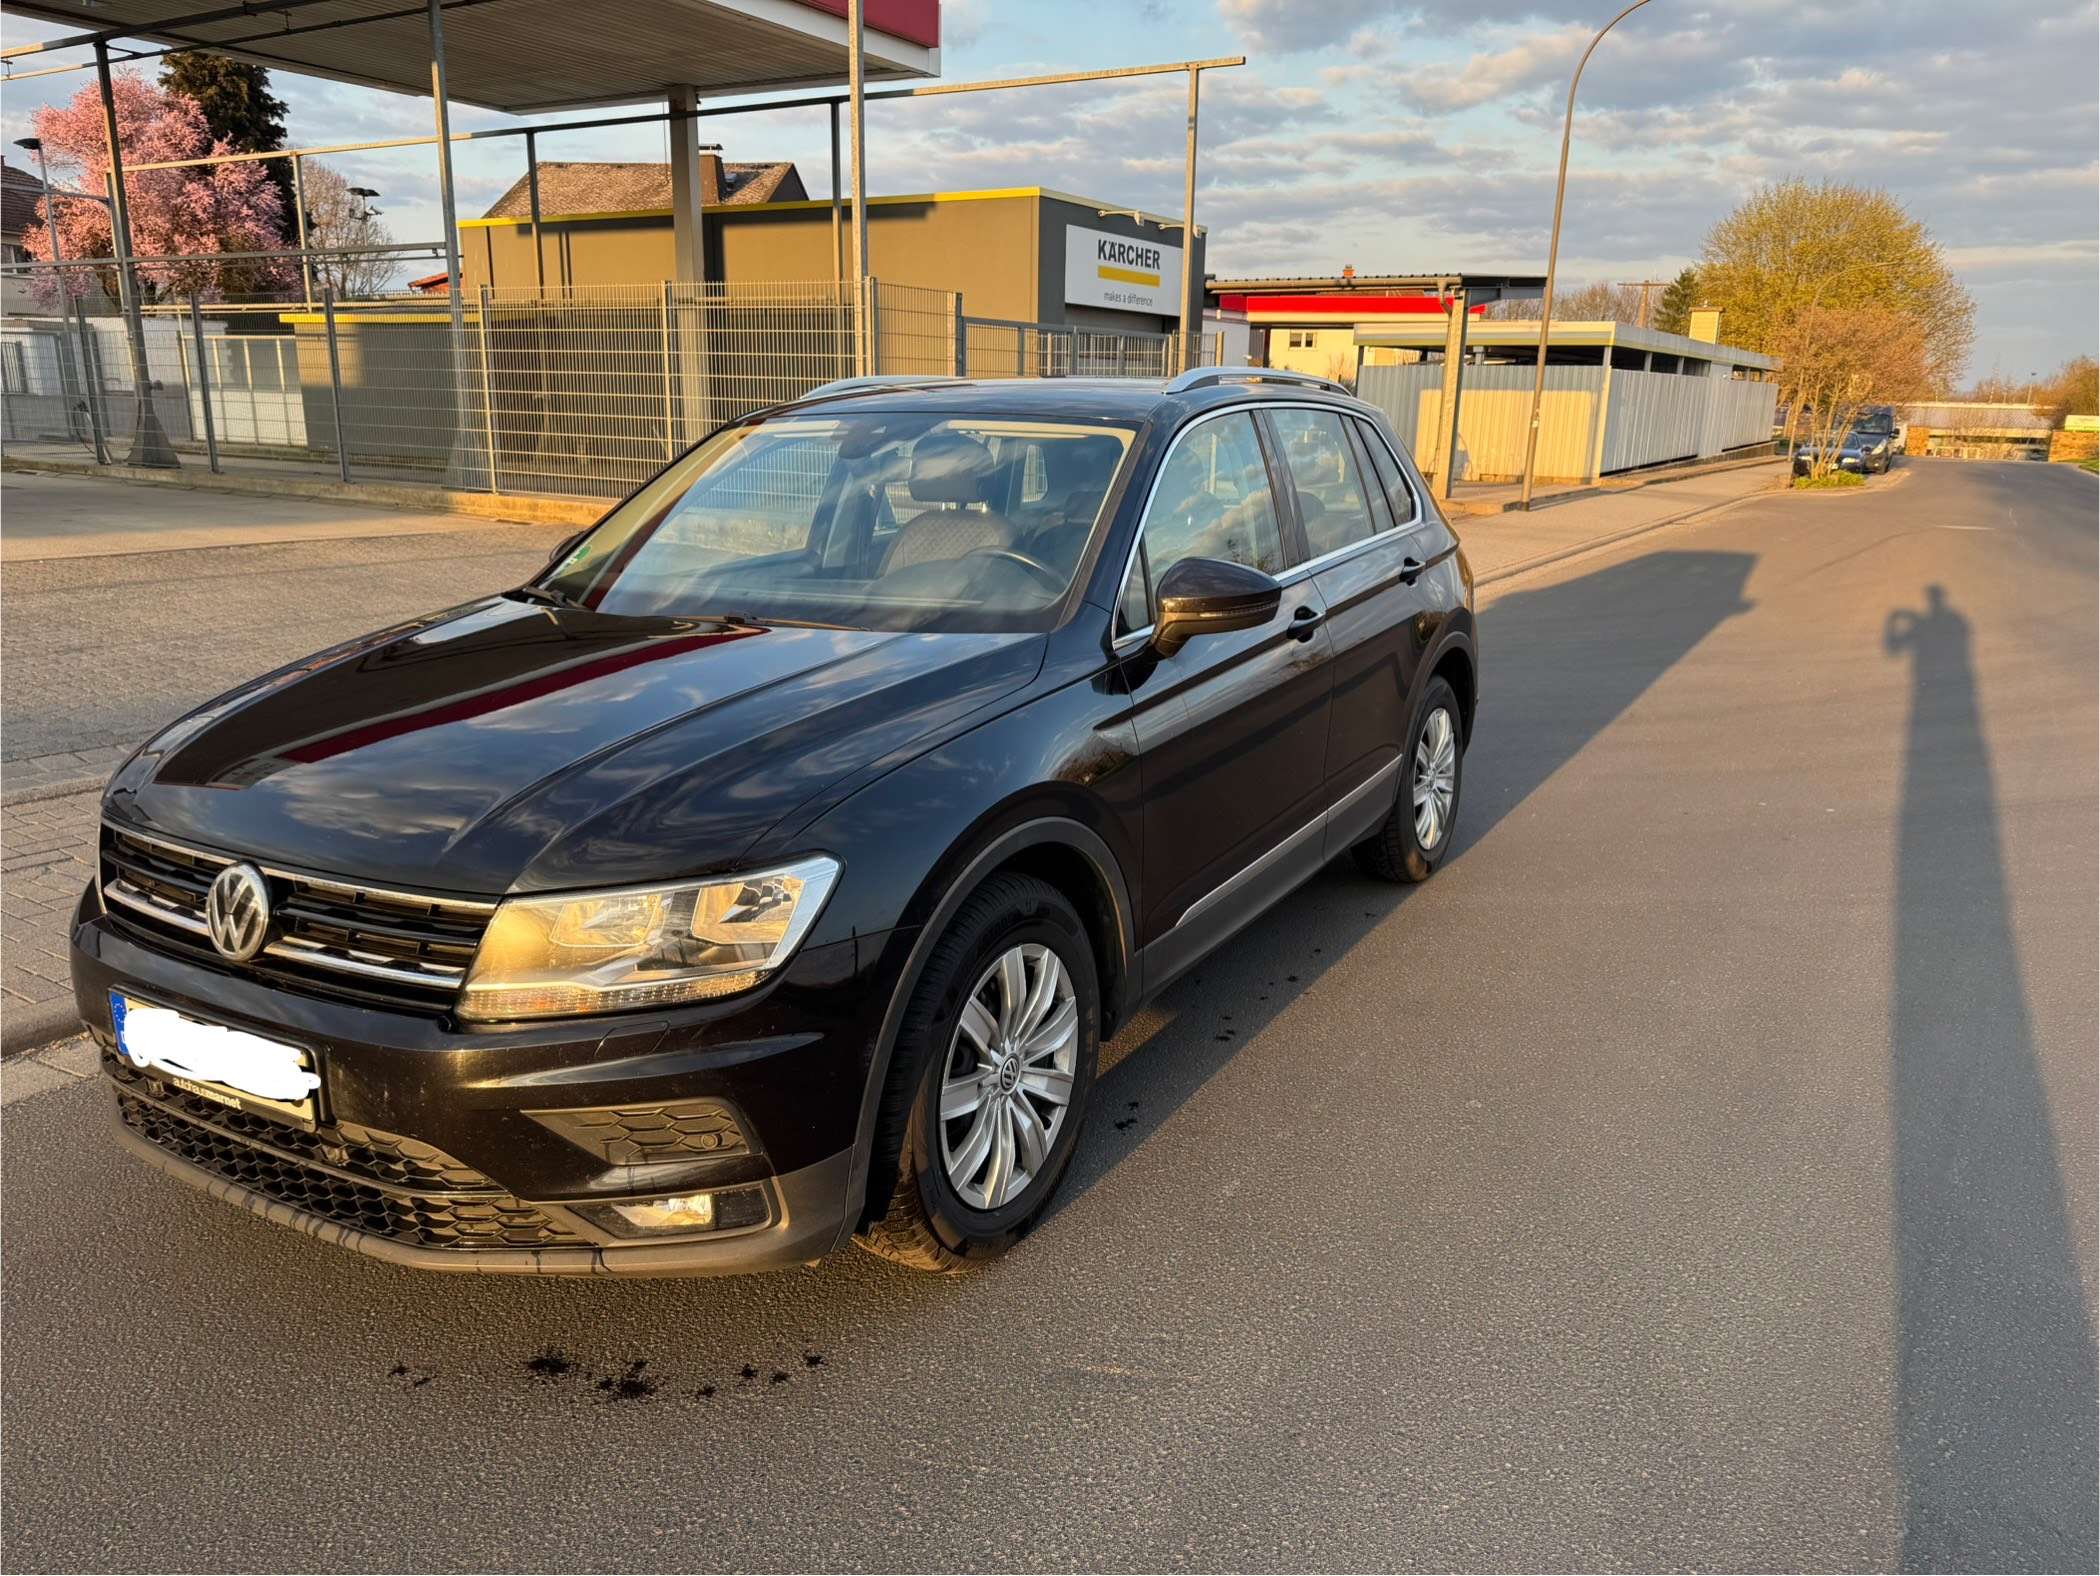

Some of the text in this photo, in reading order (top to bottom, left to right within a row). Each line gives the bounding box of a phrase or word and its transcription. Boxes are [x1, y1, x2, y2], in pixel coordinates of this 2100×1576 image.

[1097, 238, 1161, 270] KÄRCHER
[1103, 291, 1122, 303] makes
[1127, 292, 1153, 307] difference
[209, 866, 266, 957] VW
